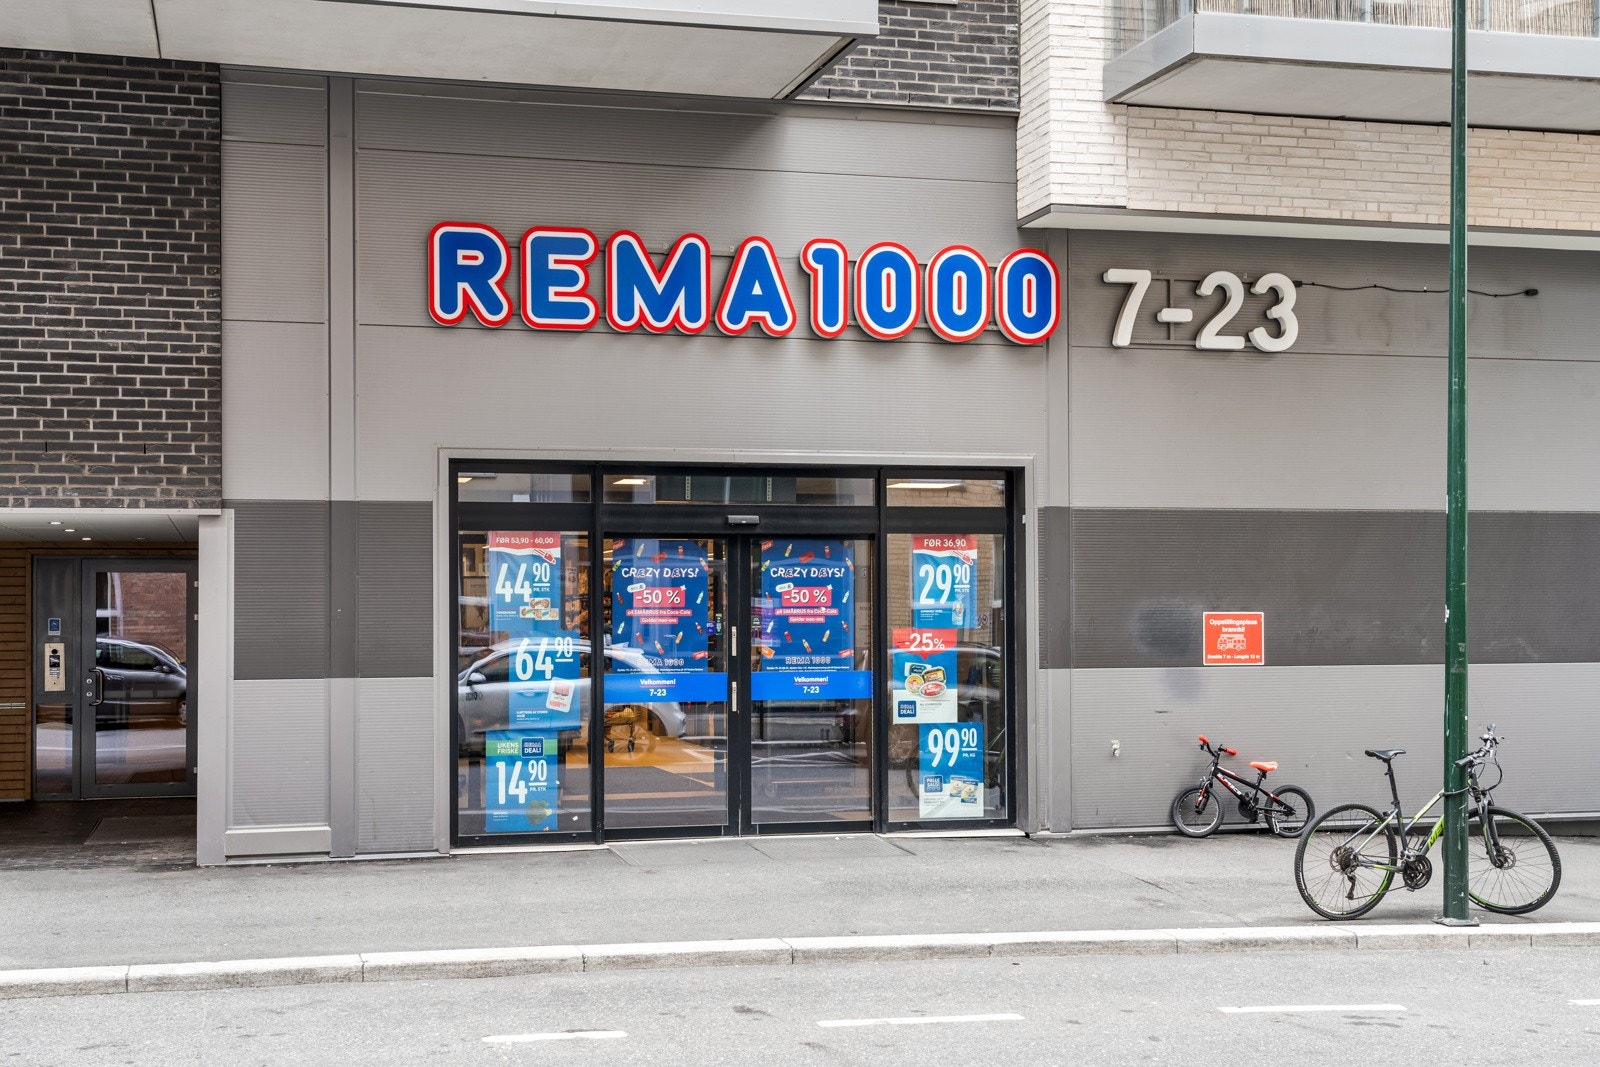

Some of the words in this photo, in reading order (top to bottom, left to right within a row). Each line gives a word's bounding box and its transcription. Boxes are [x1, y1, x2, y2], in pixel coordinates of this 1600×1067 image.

[428, 221, 797, 337] REMA
[799, 238, 1061, 345] 1000
[1103, 268, 1299, 352] 7-23
[511, 537, 529, 545] 53,90
[534, 537, 554, 545] 60,00
[924, 539, 941, 547] FØR
[943, 538, 966, 548] 36,90
[785, 656, 810, 665] REMA
[649, 688, 667, 696] 7-23
[803, 686, 820, 694] 7-23
